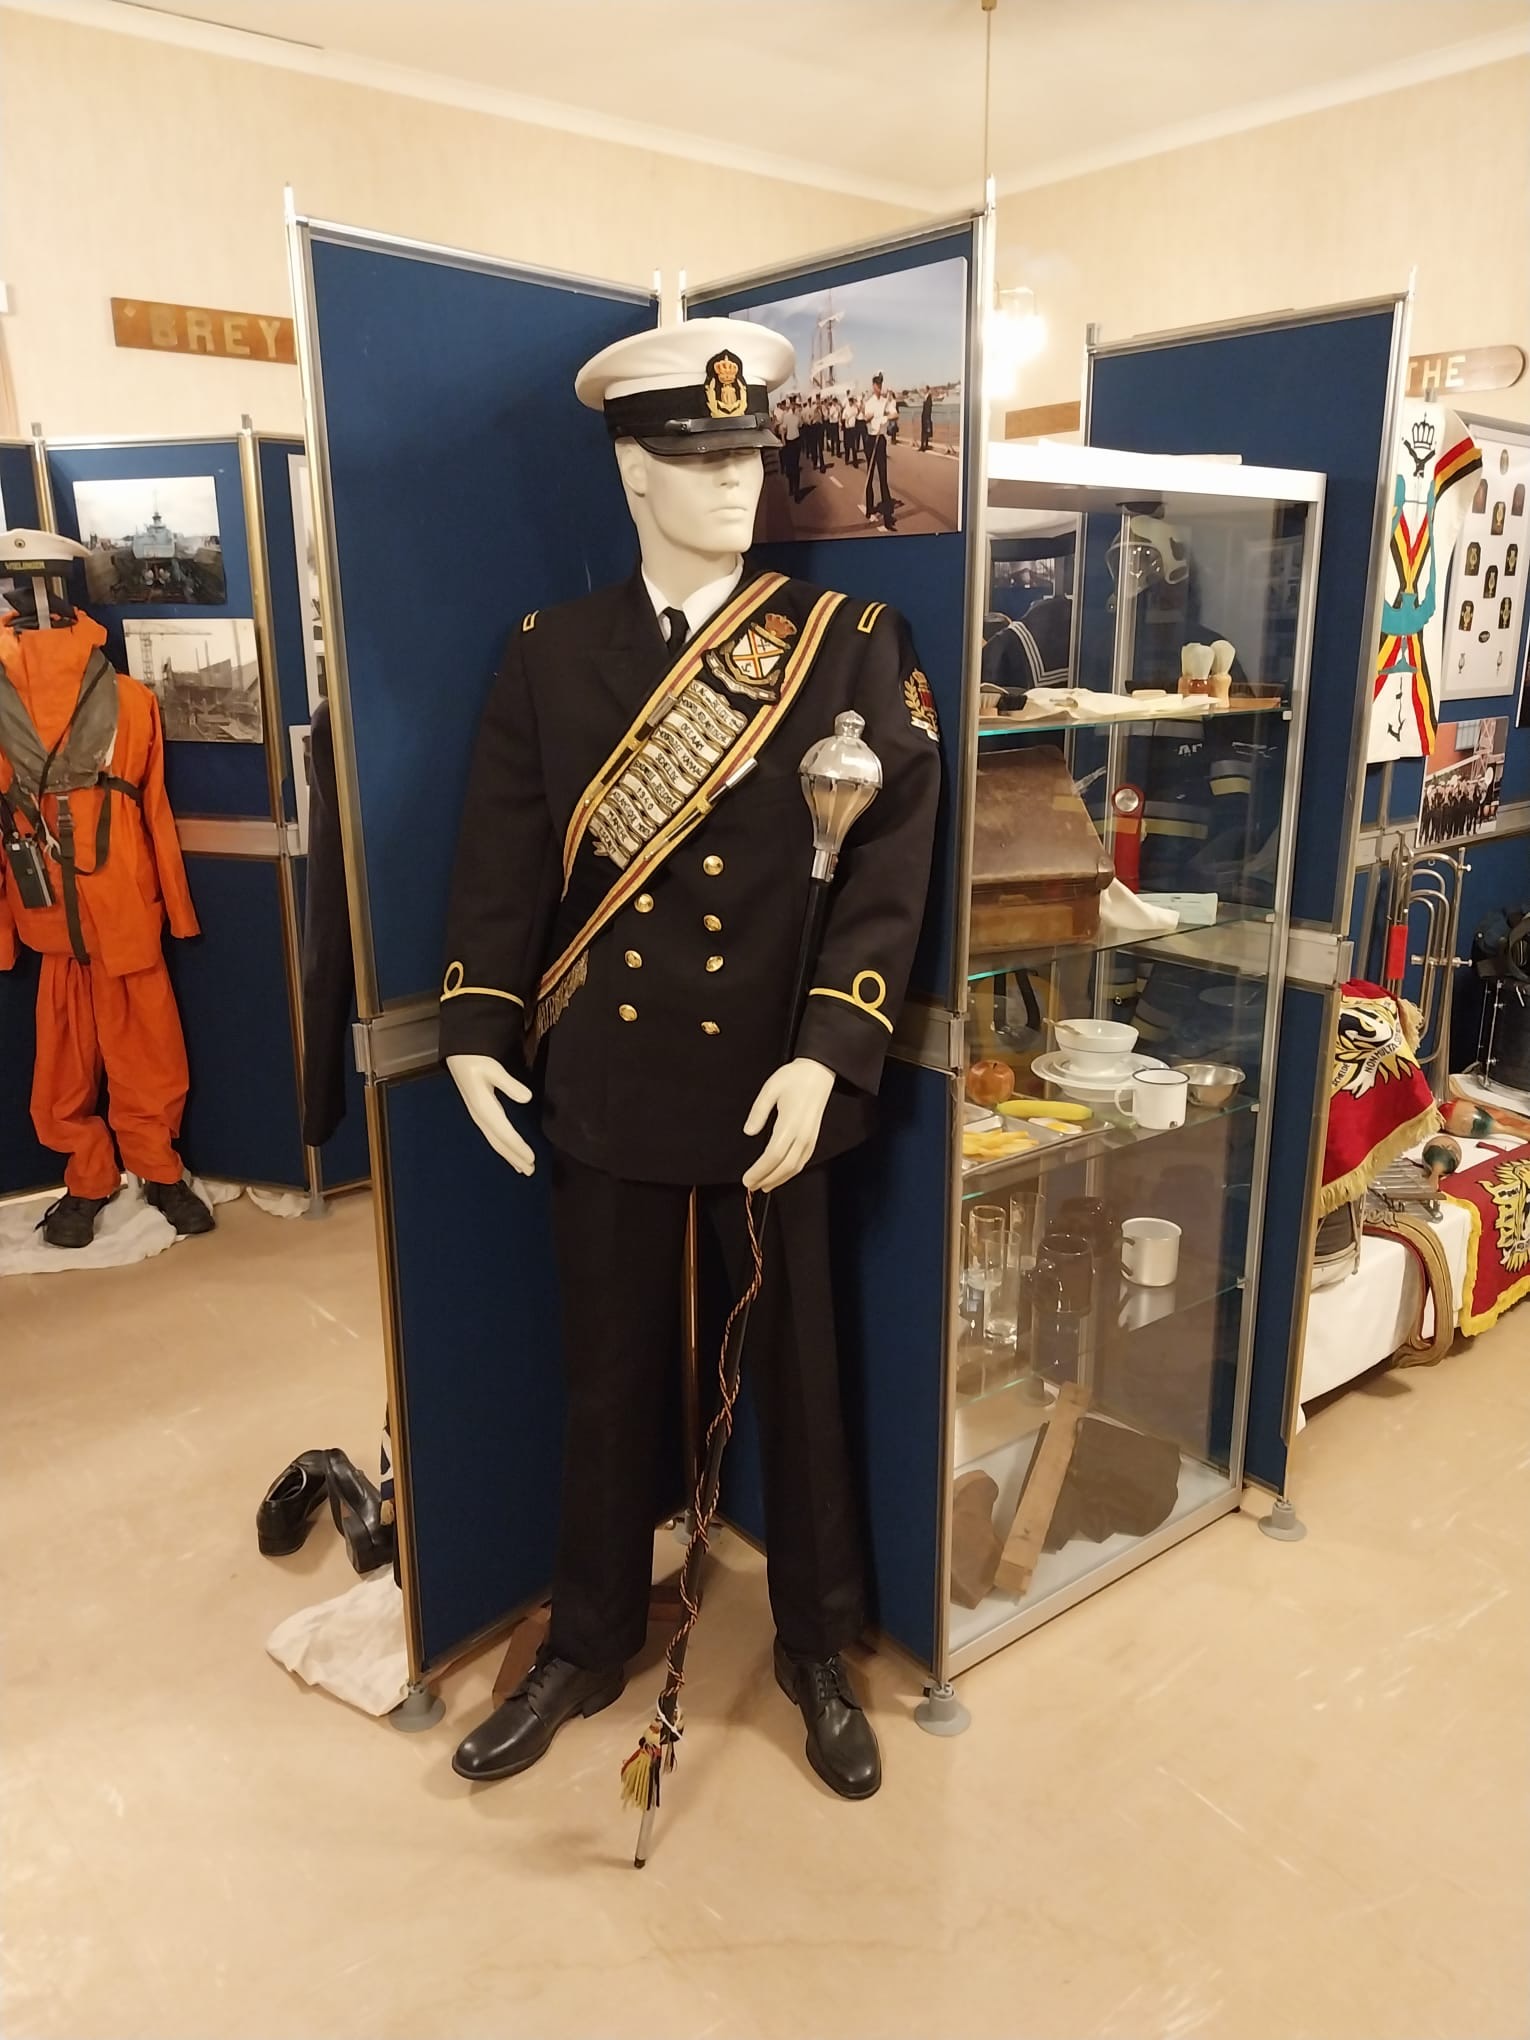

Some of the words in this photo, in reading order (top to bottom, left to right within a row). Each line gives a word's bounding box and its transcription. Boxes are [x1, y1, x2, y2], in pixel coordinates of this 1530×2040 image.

[681, 723, 704, 751] OCEAAN
[655, 753, 678, 784] SCHELDE
[637, 787, 654, 810] 1940
[1364, 1055, 1377, 1073] NON
[1376, 1042, 1398, 1061] MULTA
[1332, 1063, 1351, 1086] SCHELDE
